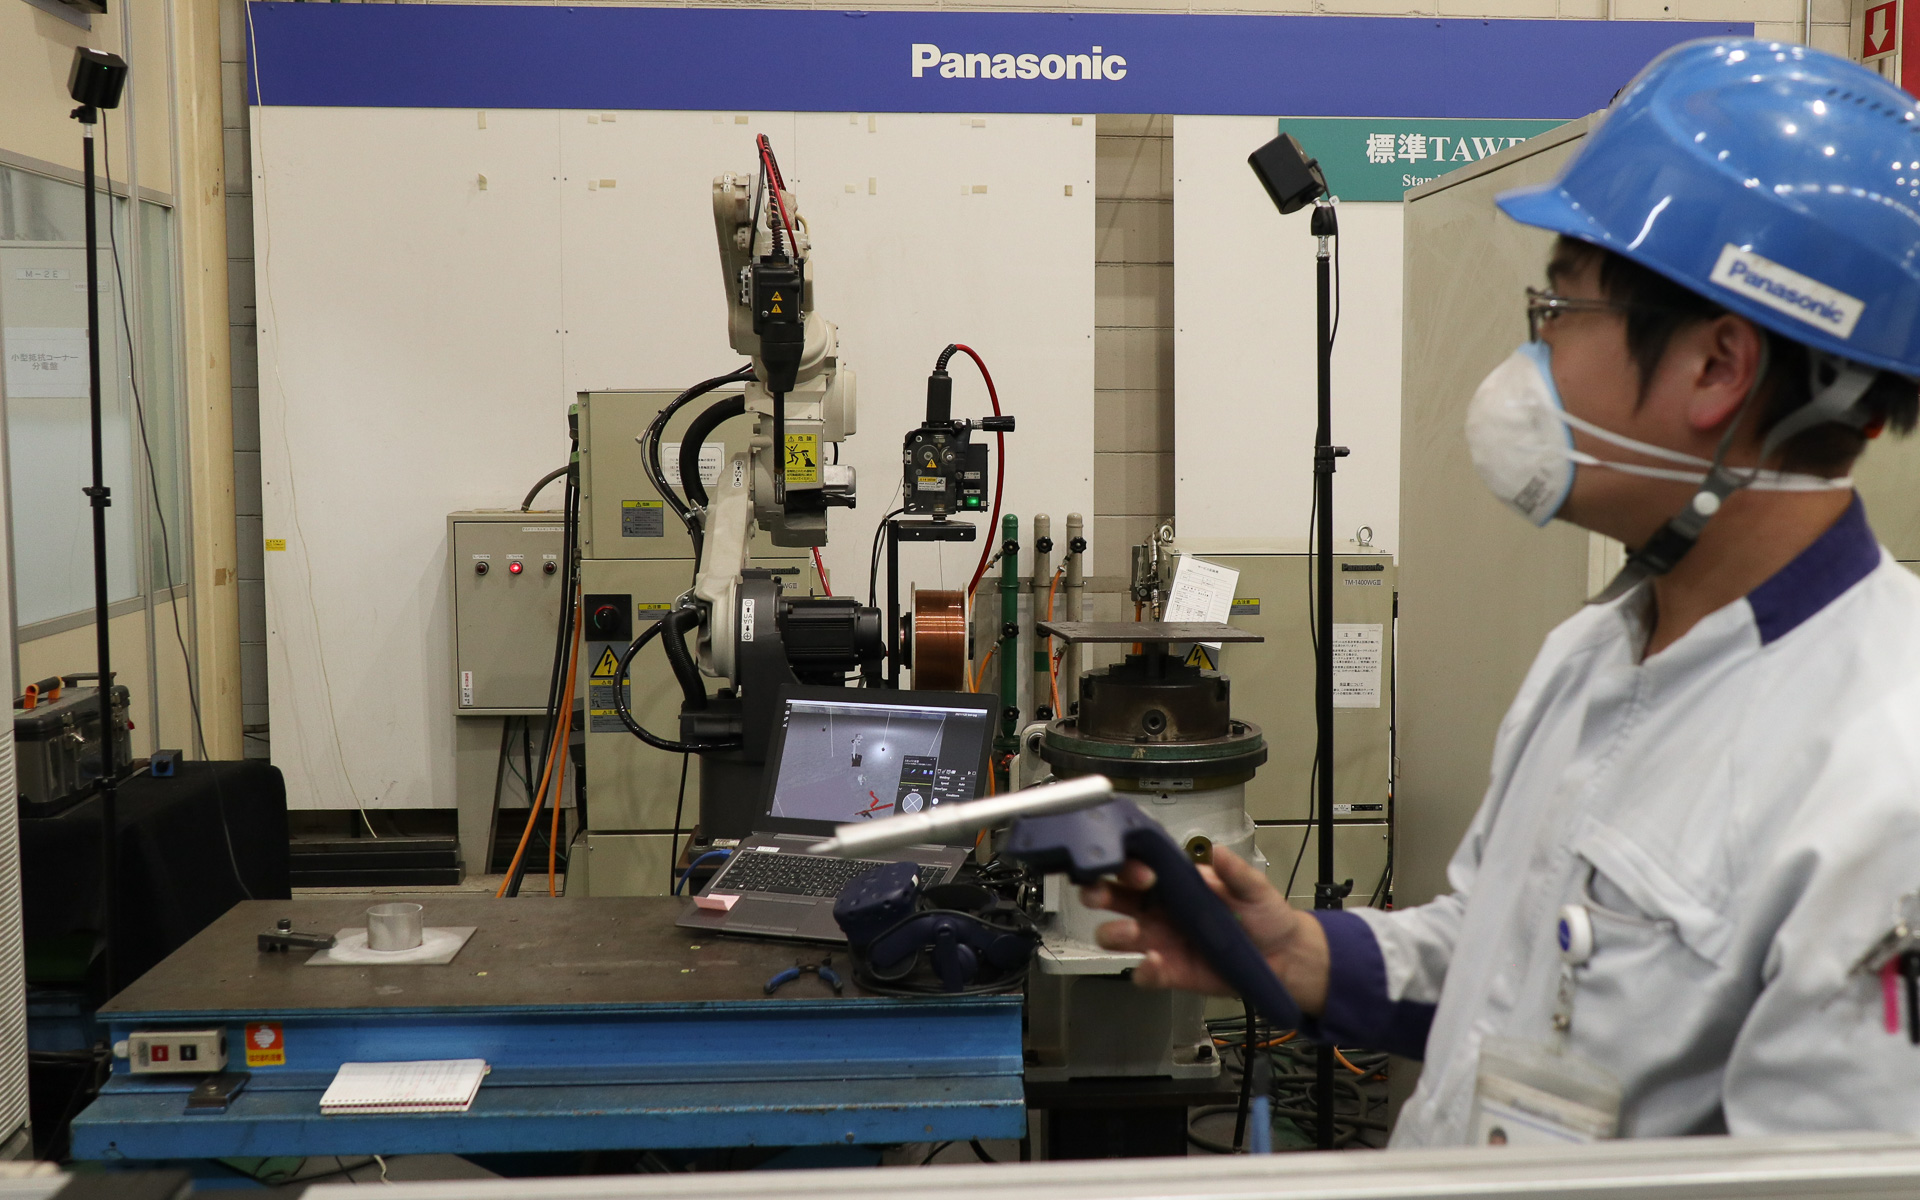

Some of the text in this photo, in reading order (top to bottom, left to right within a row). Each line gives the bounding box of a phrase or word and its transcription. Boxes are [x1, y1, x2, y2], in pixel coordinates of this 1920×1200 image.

[912, 43, 1127, 81] Panasonic
[1728, 260, 1845, 324] Panasonic
[1341, 563, 1385, 572] Panasonic
